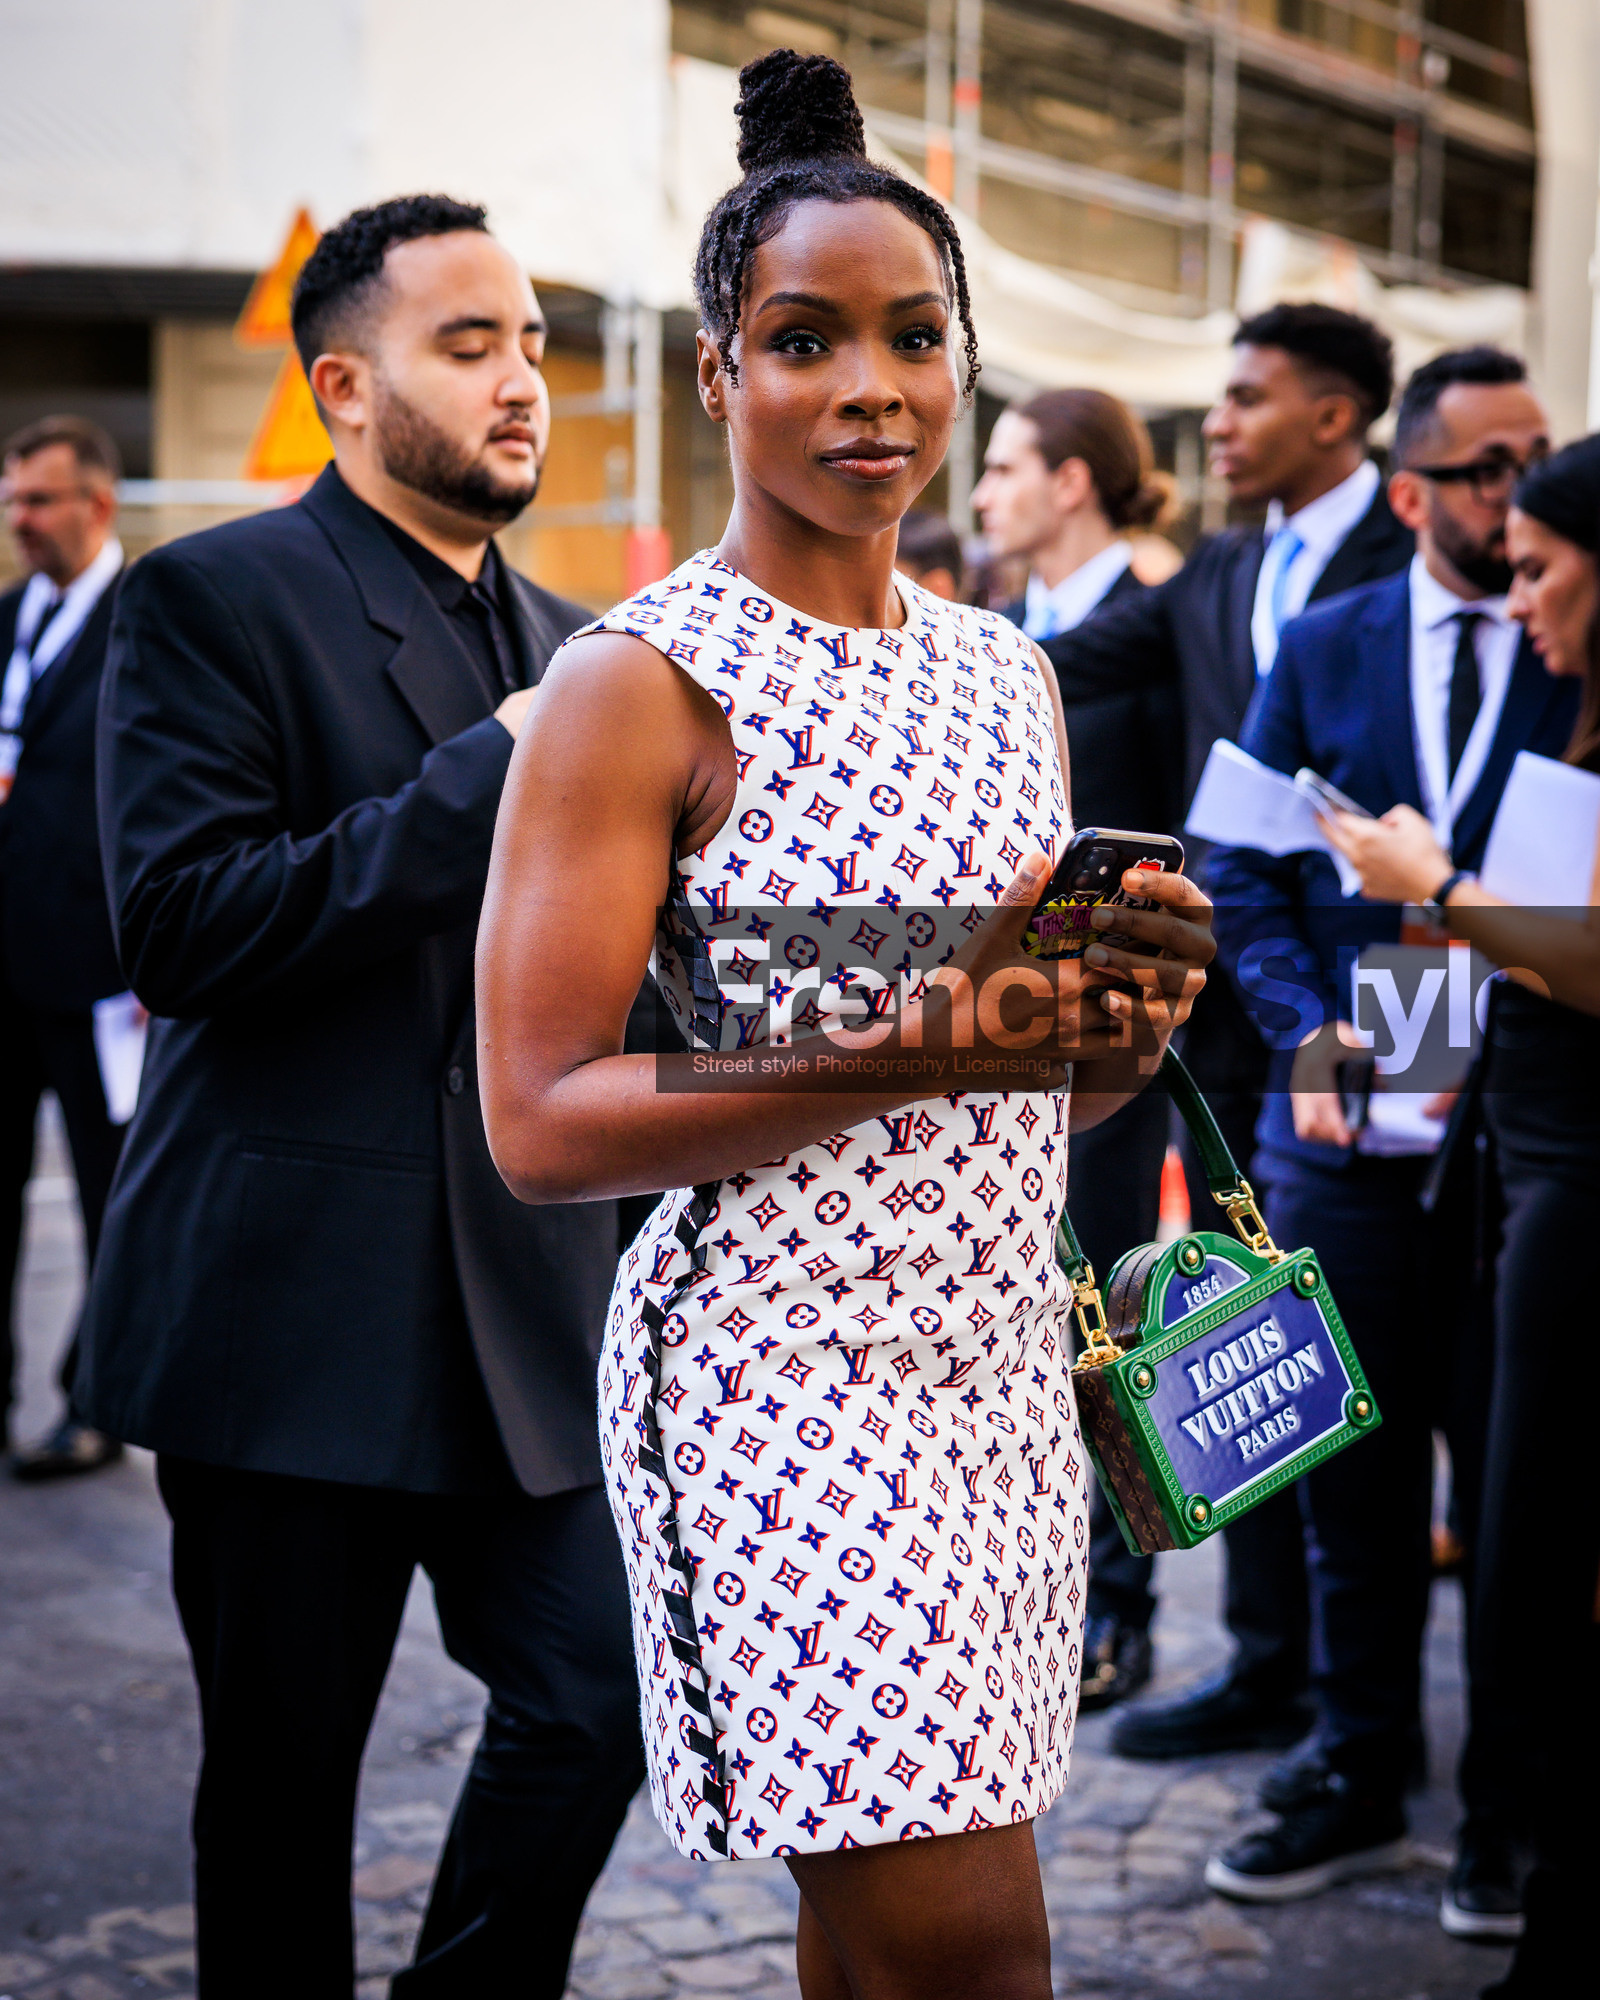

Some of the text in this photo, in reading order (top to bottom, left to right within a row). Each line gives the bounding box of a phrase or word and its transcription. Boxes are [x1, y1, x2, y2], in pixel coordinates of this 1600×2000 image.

[1182, 1274, 1222, 1310] 1854
[1188, 1318, 1283, 1398] LOUIS
[1181, 1345, 1323, 1448] VUITTON
[1236, 1407, 1298, 1460] PARIS
